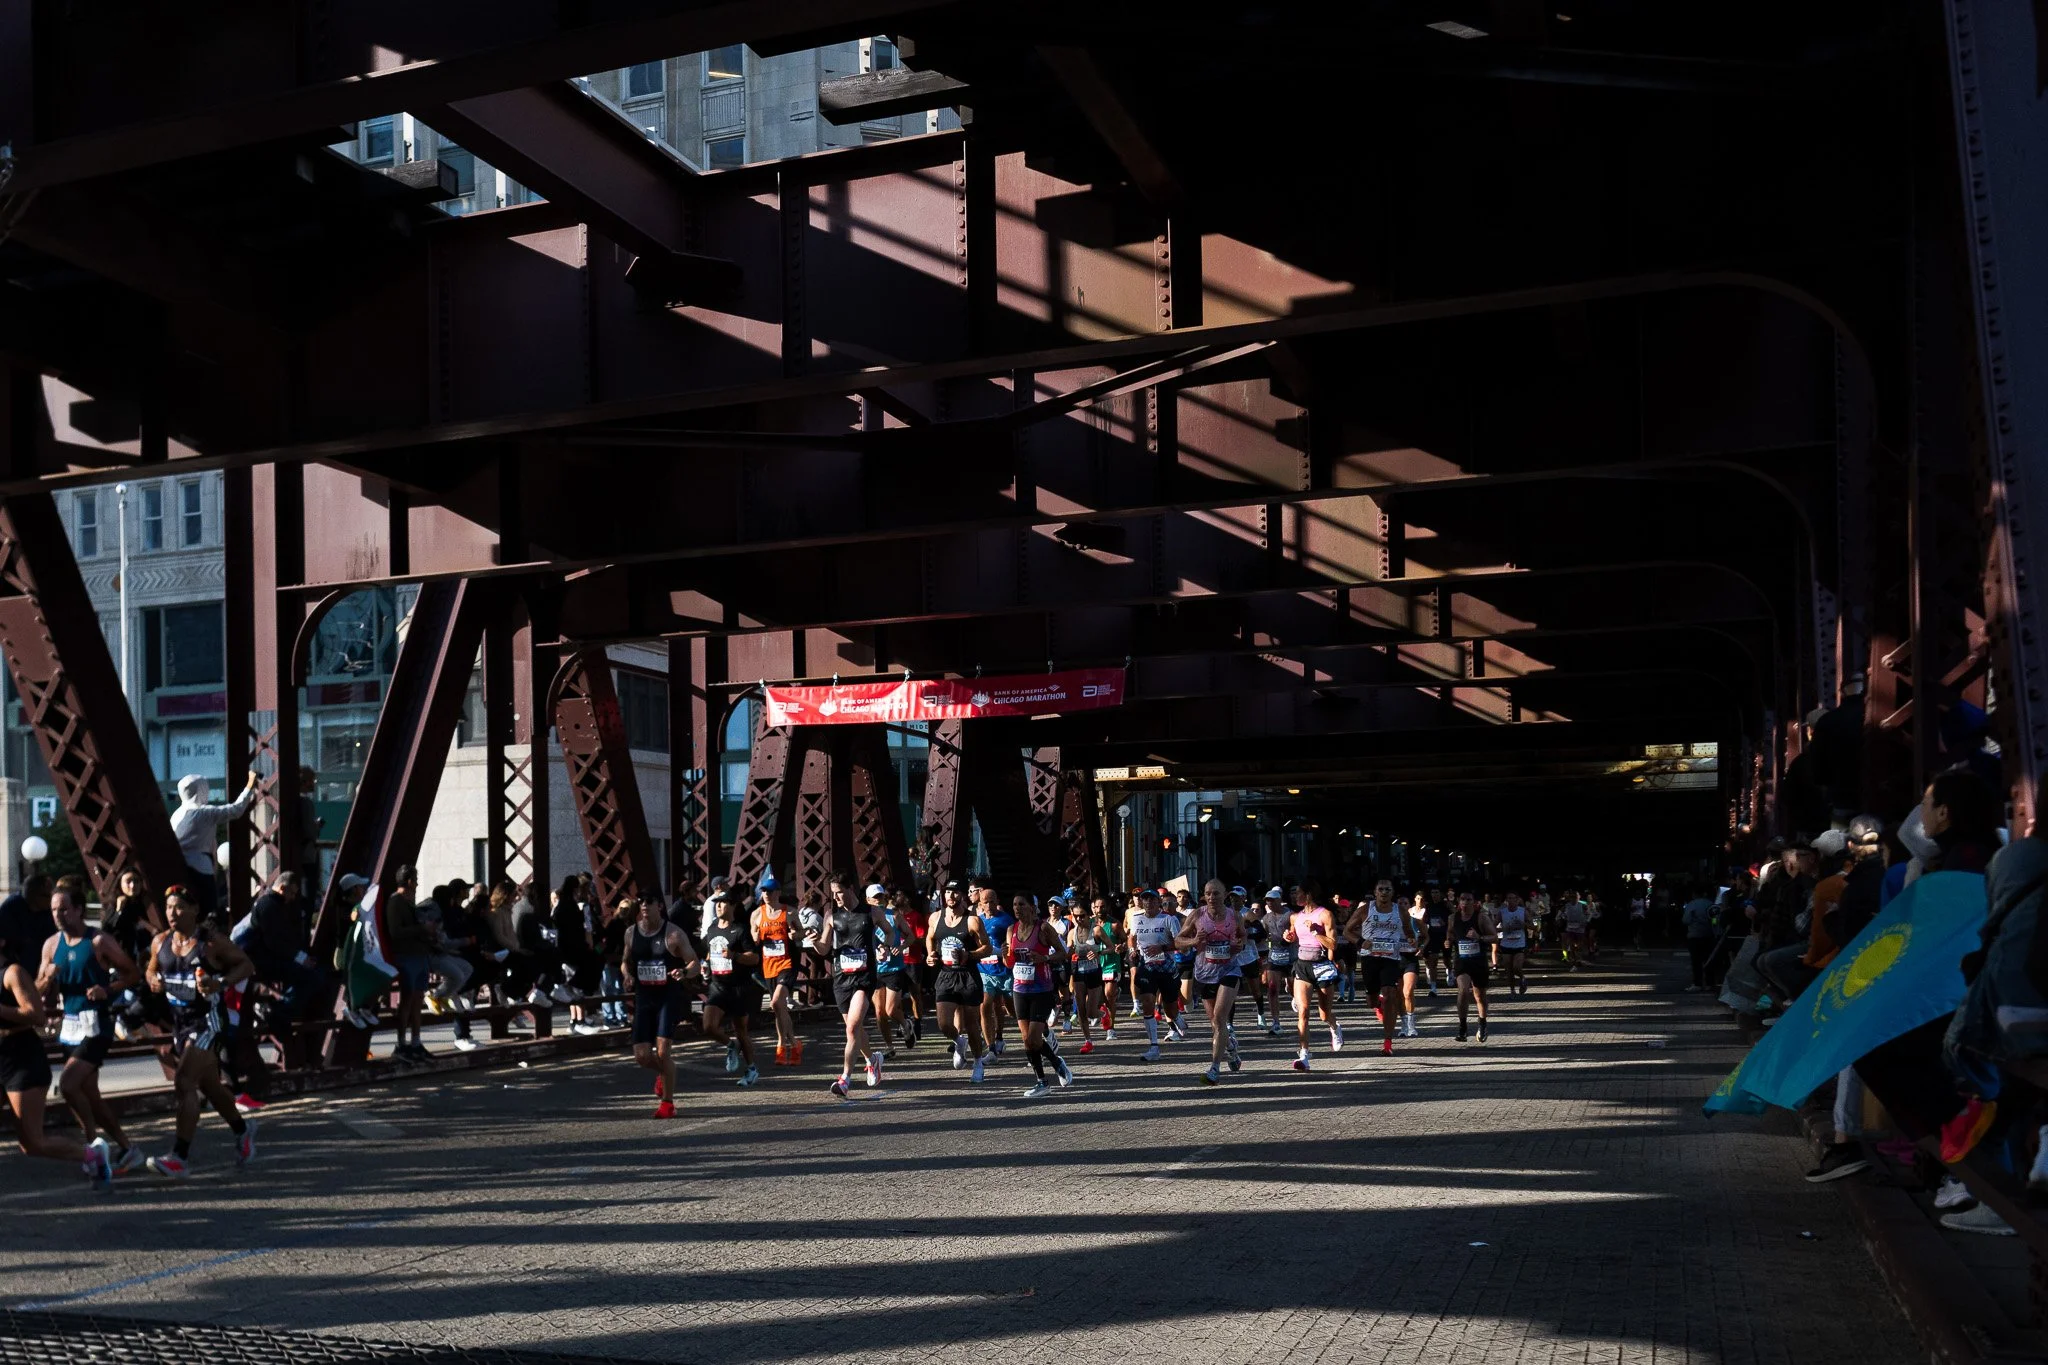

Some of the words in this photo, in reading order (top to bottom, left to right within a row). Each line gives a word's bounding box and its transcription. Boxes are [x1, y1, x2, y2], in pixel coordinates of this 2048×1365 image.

[993, 696, 1025, 705] CHICAGO
[1025, 692, 1066, 702] MARATHON
[840, 704, 870, 714] CHICAGO
